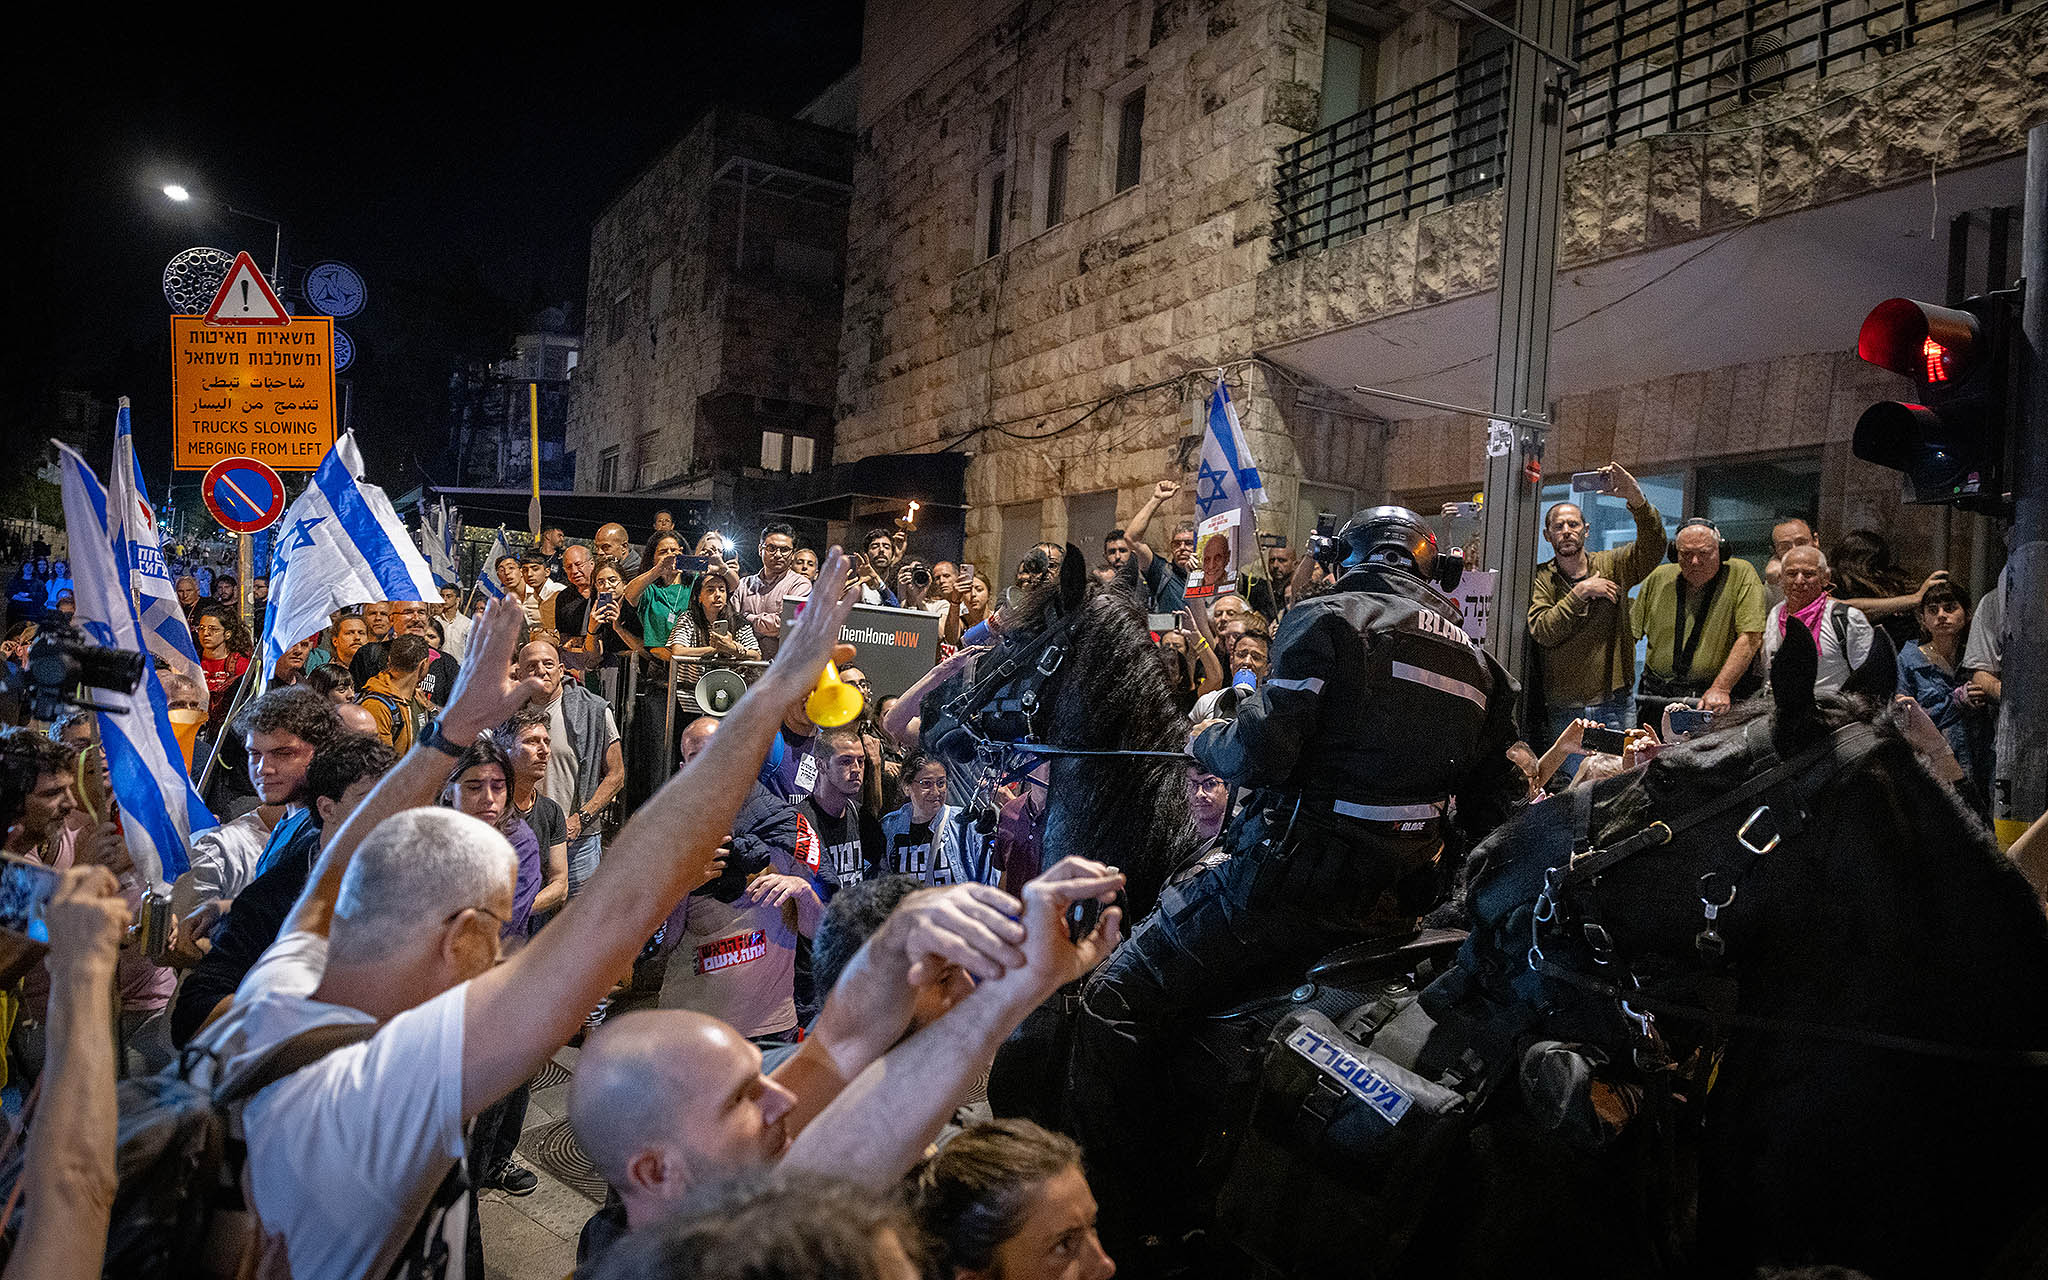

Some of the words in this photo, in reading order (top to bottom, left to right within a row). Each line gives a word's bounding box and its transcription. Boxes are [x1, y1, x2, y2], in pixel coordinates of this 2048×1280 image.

[189, 331, 247, 345] מאיטות
[257, 332, 315, 345] משאיות
[184, 350, 239, 365] משמאל
[248, 352, 321, 366] ומשתלבות
[190, 398, 232, 414] اليسار
[241, 402, 264, 413] من
[274, 400, 319, 415] تندمج
[192, 421, 249, 434] TRUCKS
[254, 421, 317, 434] SLOWING
[188, 442, 246, 455] MERGING
[251, 442, 287, 455] FROM
[292, 442, 322, 455] LEFT
[740, 943, 766, 962] אתה
[703, 951, 739, 971] אשם
[1297, 1032, 1402, 1112] משטרה
